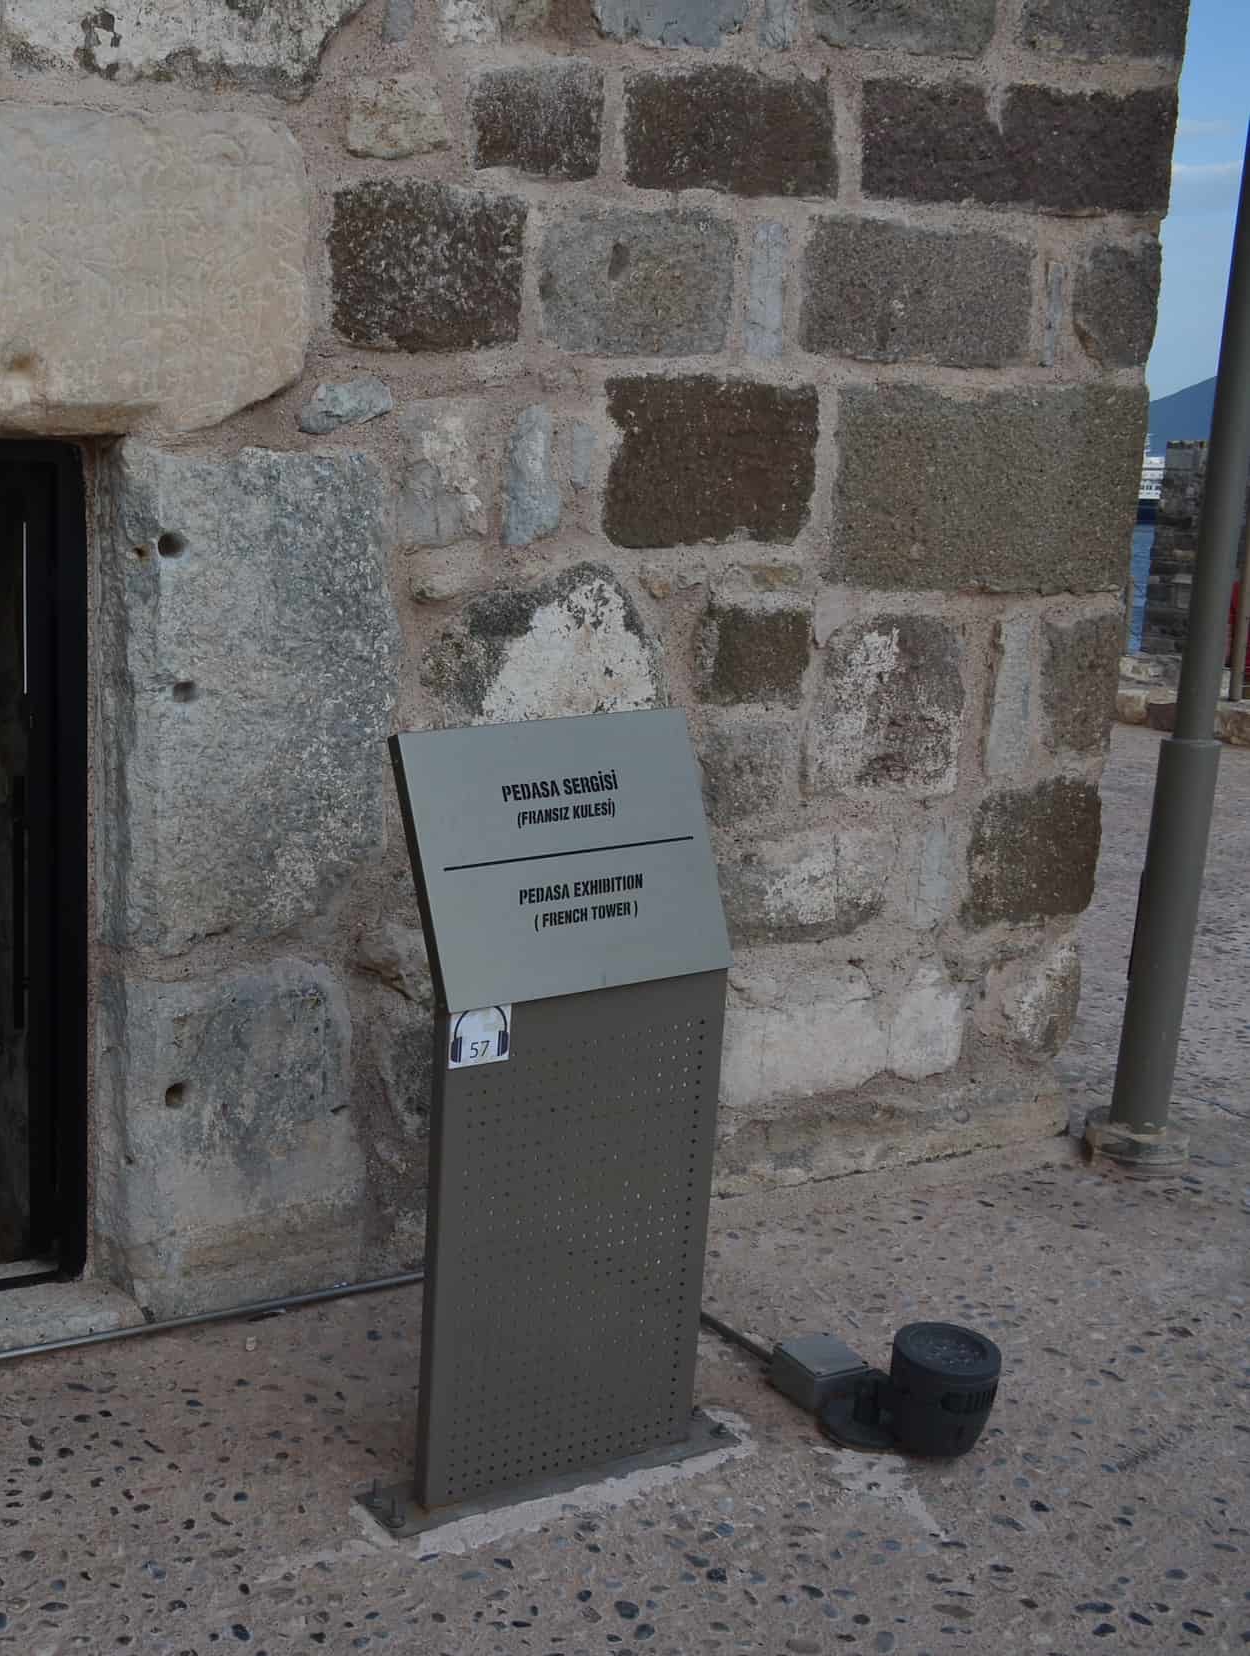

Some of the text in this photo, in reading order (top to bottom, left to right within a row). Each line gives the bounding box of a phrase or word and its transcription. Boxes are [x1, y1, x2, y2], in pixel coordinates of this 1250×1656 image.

[502, 769, 618, 802] PEDASA SERGİSİ
[517, 798, 616, 828] (FRANSIZ KULESİ)
[519, 873, 643, 905] PEDASA EXHIBITION
[469, 1040, 490, 1059] 57
